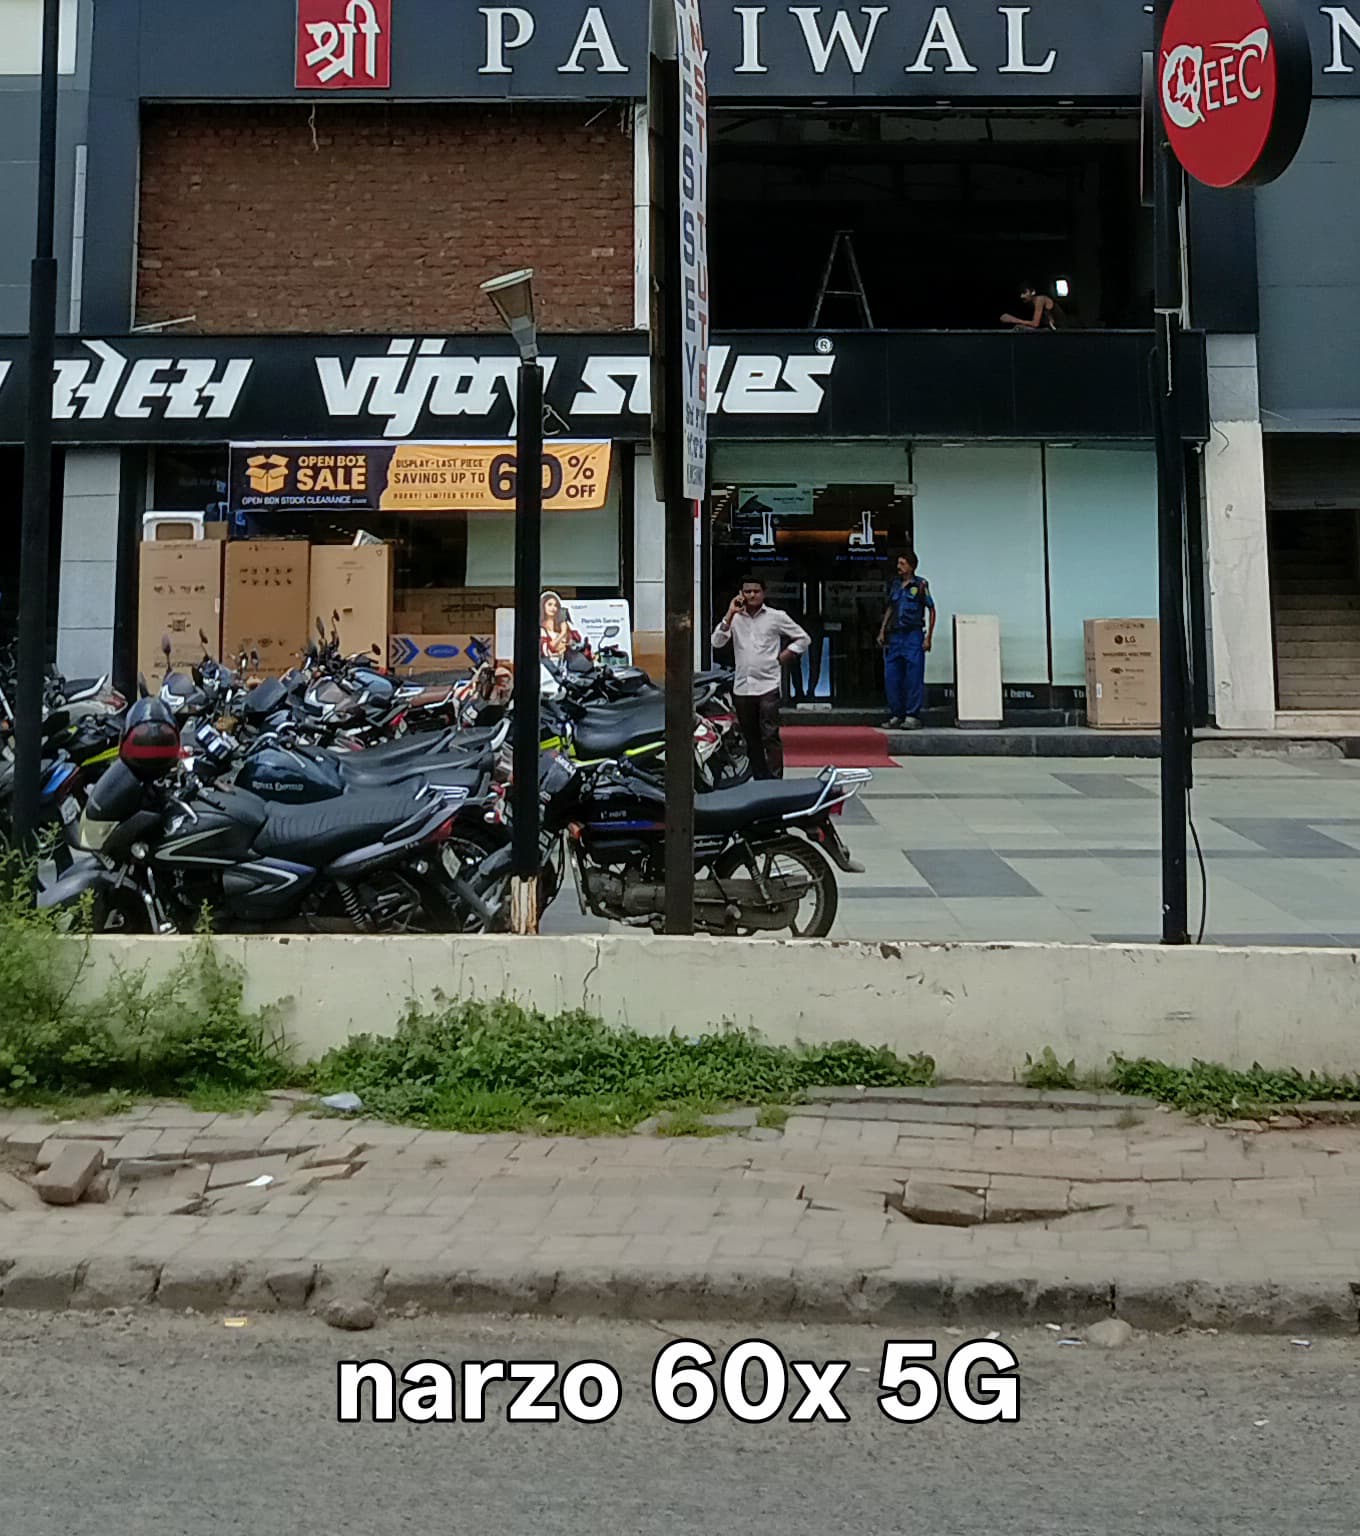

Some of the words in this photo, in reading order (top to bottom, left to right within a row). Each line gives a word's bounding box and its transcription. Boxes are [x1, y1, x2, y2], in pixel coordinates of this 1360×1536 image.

[478, 5, 1058, 75] PAIWAL
[298, 455, 335, 467] OPEN
[337, 455, 367, 467] BOX
[296, 467, 367, 491] SALE
[394, 472, 447, 484] SAVINGS
[451, 472, 467, 483] UP
[471, 471, 486, 483] TO
[565, 484, 596, 499] OFF
[242, 496, 262, 506] OPEN
